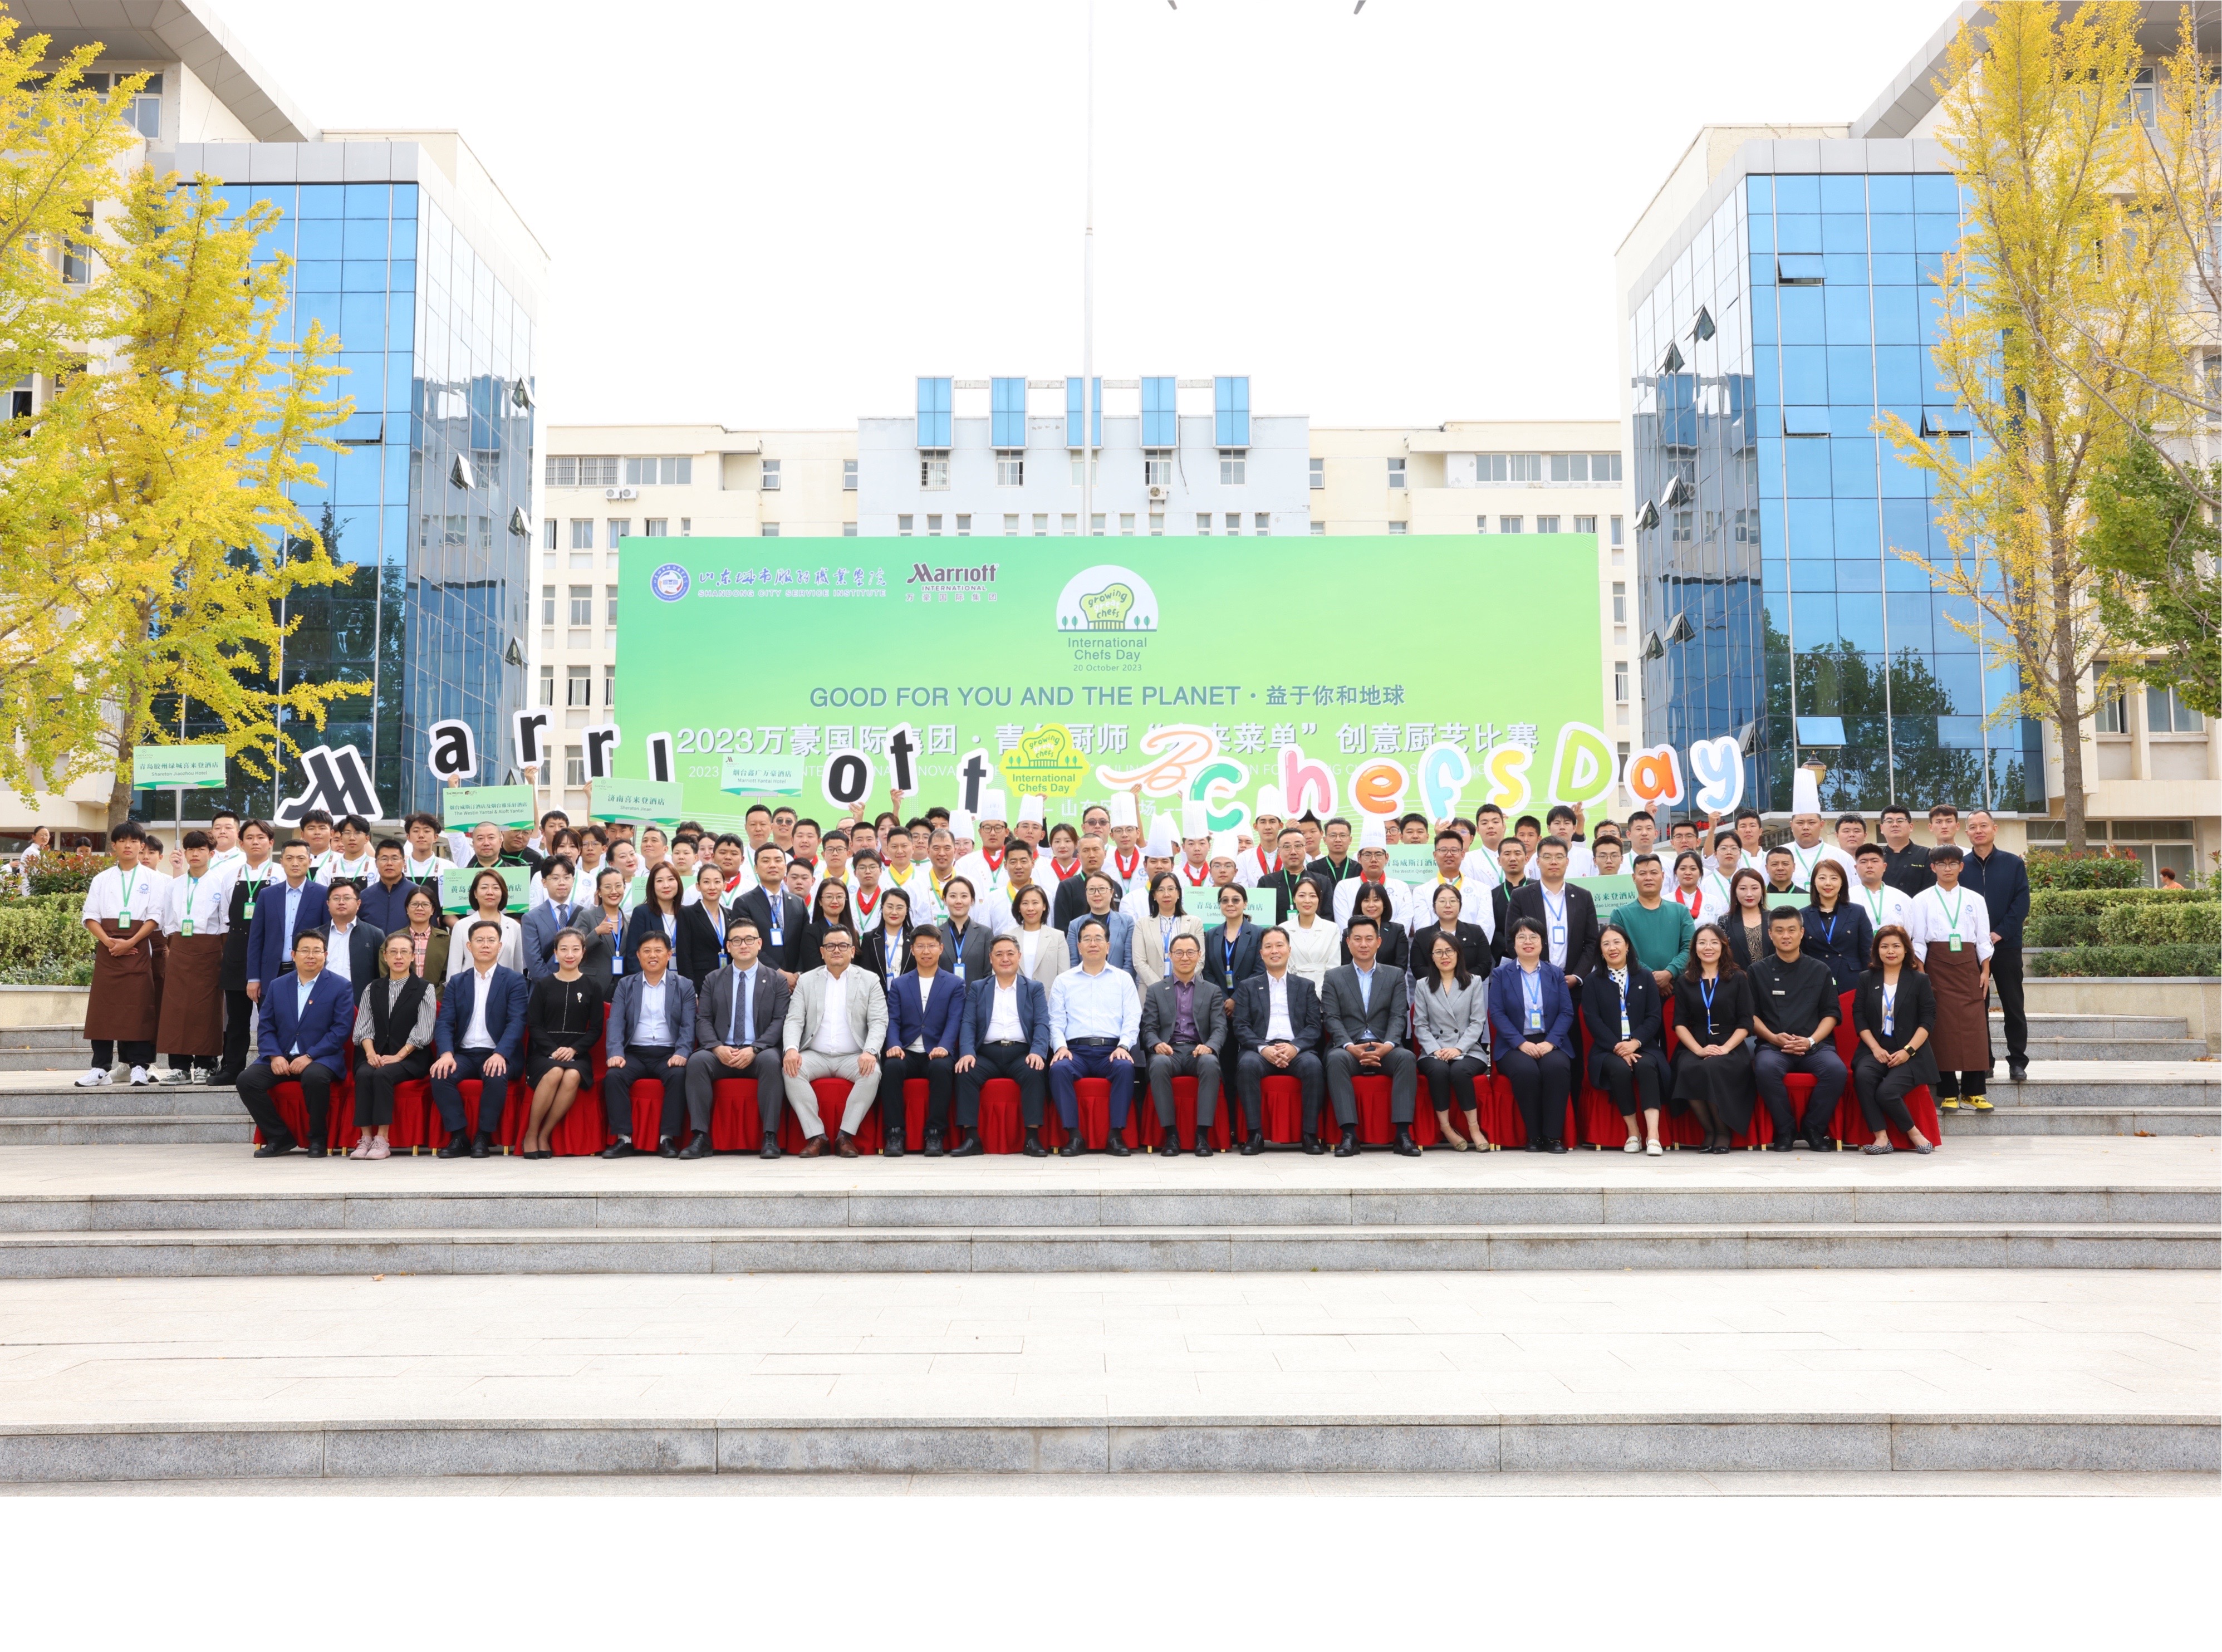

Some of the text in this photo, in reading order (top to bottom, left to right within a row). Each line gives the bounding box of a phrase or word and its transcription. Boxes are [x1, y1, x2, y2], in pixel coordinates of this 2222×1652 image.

[906, 563, 996, 584] Marriott
[1088, 590, 1127, 607] growing
[1094, 600, 1121, 612] great
[1097, 609, 1120, 619] chefs
[1068, 638, 1147, 648] International
[1075, 649, 1140, 662] Chefs Day
[810, 687, 887, 707] GOOD
[896, 687, 949, 707] FOR
[957, 687, 1012, 707] YOU
[1020, 687, 1074, 706] AND
[1082, 686, 1133, 705] THE
[1142, 686, 1242, 705] PLANET
[1265, 684, 1405, 706] 益于你和地球
[1029, 734, 1060, 749] growing
[1033, 743, 1054, 754] great
[1036, 750, 1054, 758] chefs
[689, 766, 719, 777] 2023
[733, 769, 792, 777] 烟台鑫广万豪酒店
[1013, 773, 1075, 782] International
[1018, 783, 1070, 794] Chefs Day
[607, 794, 665, 806] 济南喜来登酒店
